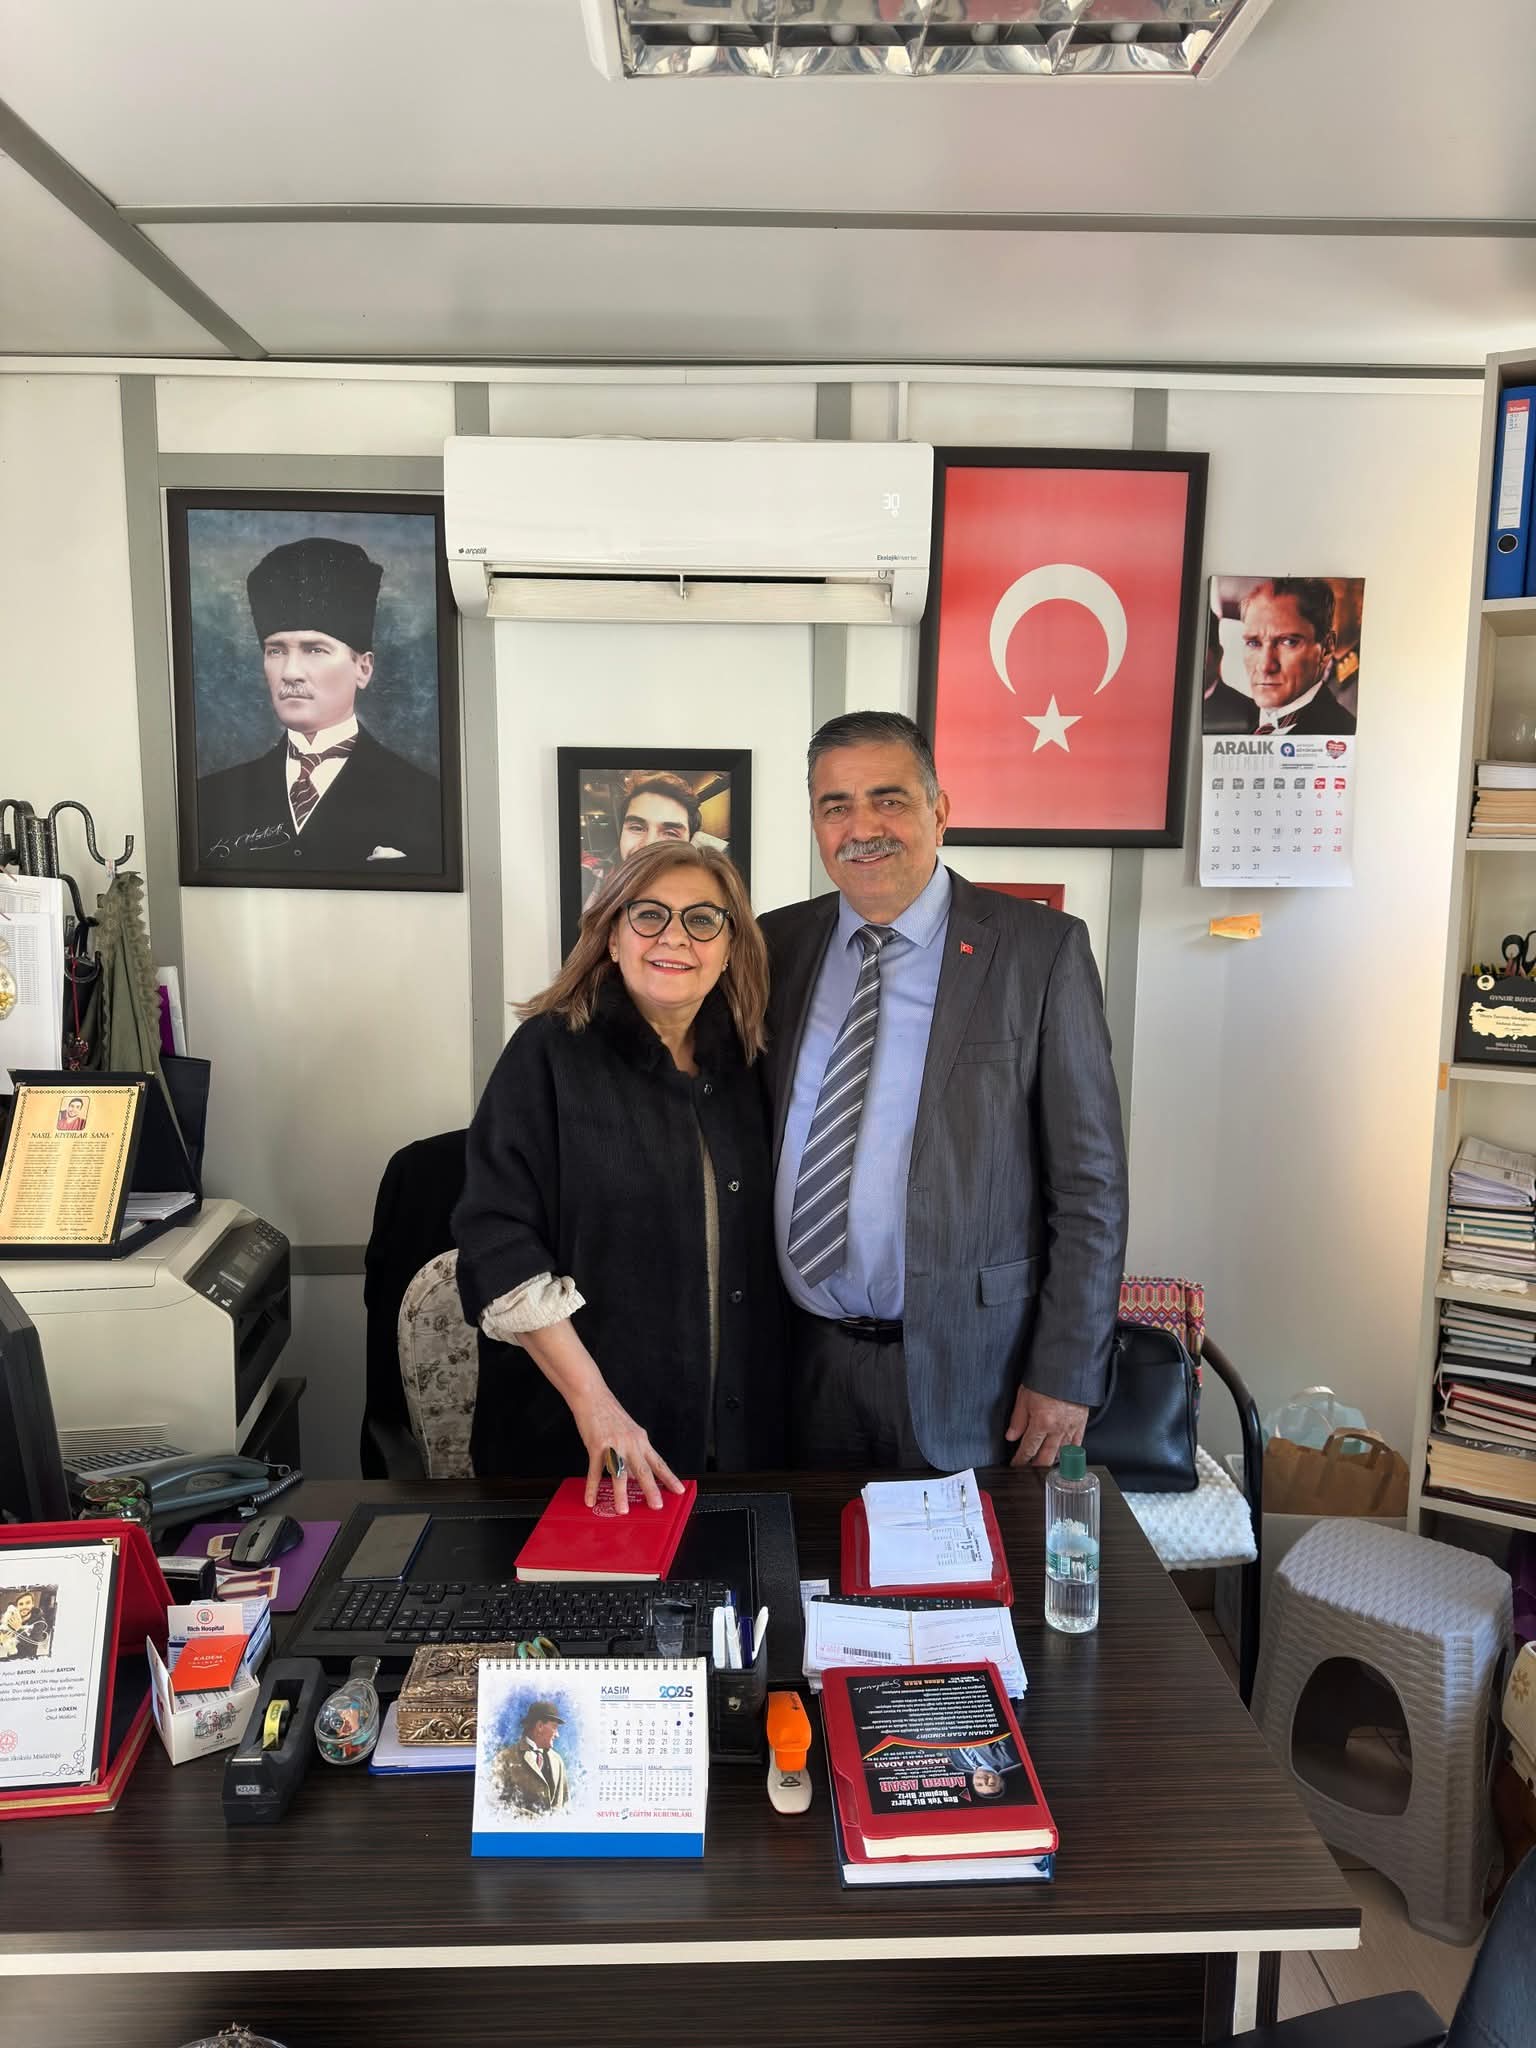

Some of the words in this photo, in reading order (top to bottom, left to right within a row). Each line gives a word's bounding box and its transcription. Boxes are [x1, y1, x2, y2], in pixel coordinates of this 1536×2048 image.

[882, 493, 900, 510] 30
[1213, 742, 1274, 755] ARALIK
[601, 1686, 630, 1694] KASIM
[659, 1686, 693, 1698] 2025
[879, 1780, 918, 1791] ASAR
[922, 1776, 966, 1787] Adnan
